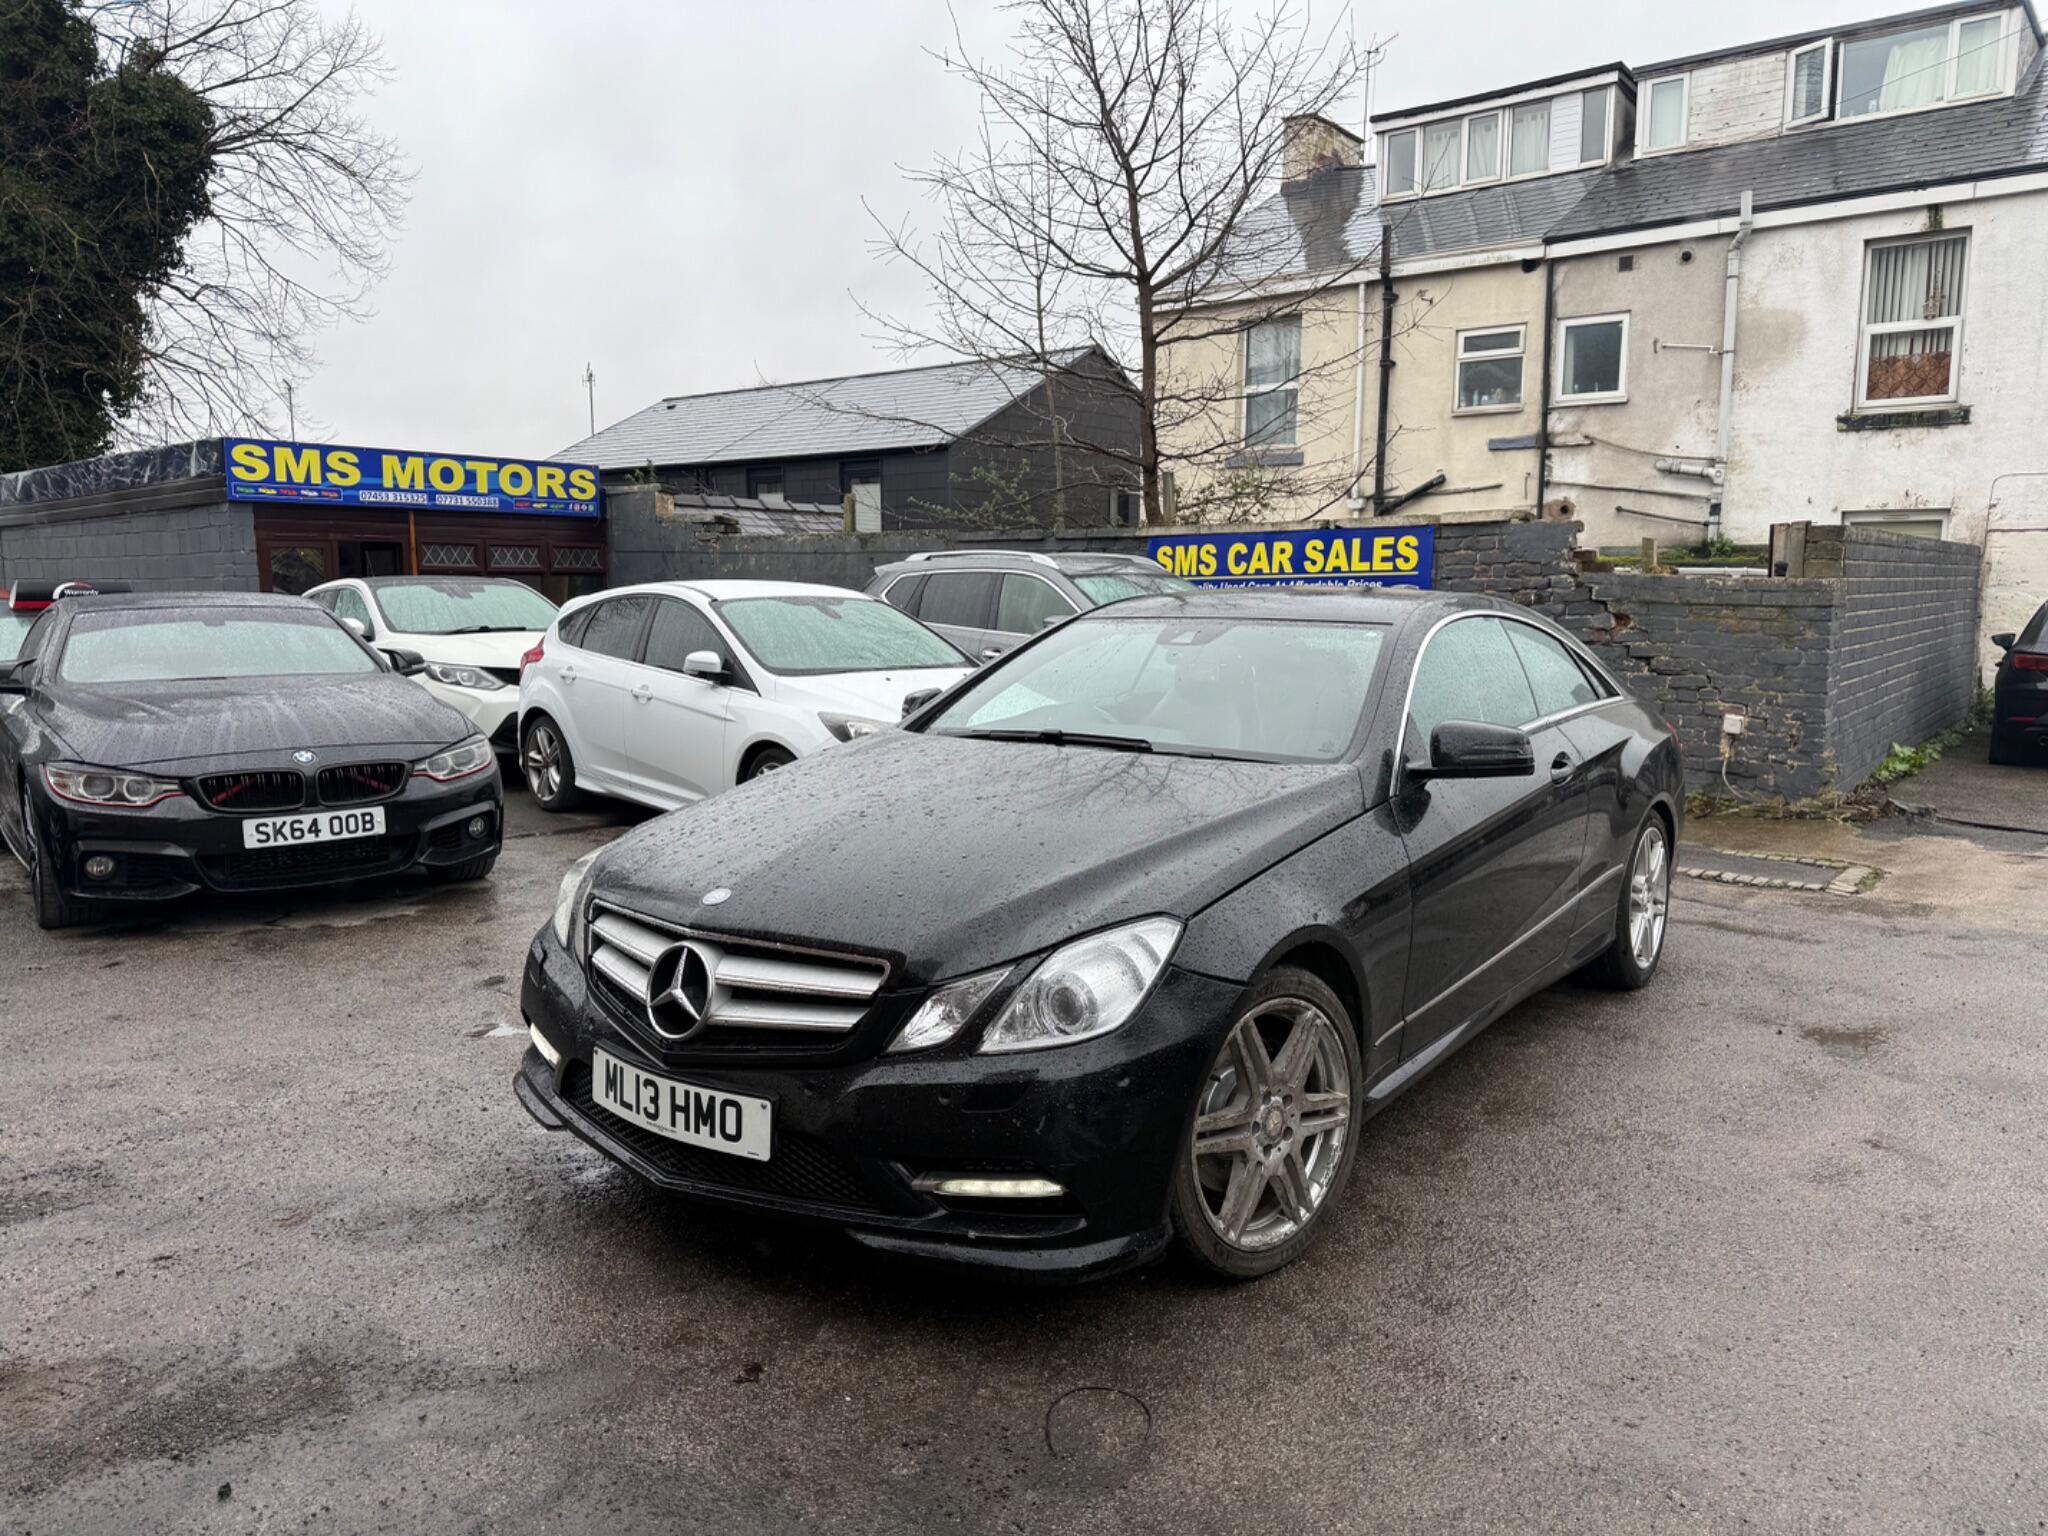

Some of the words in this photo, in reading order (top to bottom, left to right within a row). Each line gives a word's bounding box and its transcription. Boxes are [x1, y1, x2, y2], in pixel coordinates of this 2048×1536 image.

[231, 443, 362, 486] SMS
[381, 454, 597, 500] MOTORS
[1157, 543, 1217, 576] SMS
[1227, 541, 1293, 575] CAR
[1303, 535, 1419, 573] SALES
[255, 818, 321, 843] SK64
[329, 812, 375, 836] OOB
[605, 1058, 660, 1121] ML13
[670, 1086, 742, 1143] HMO
